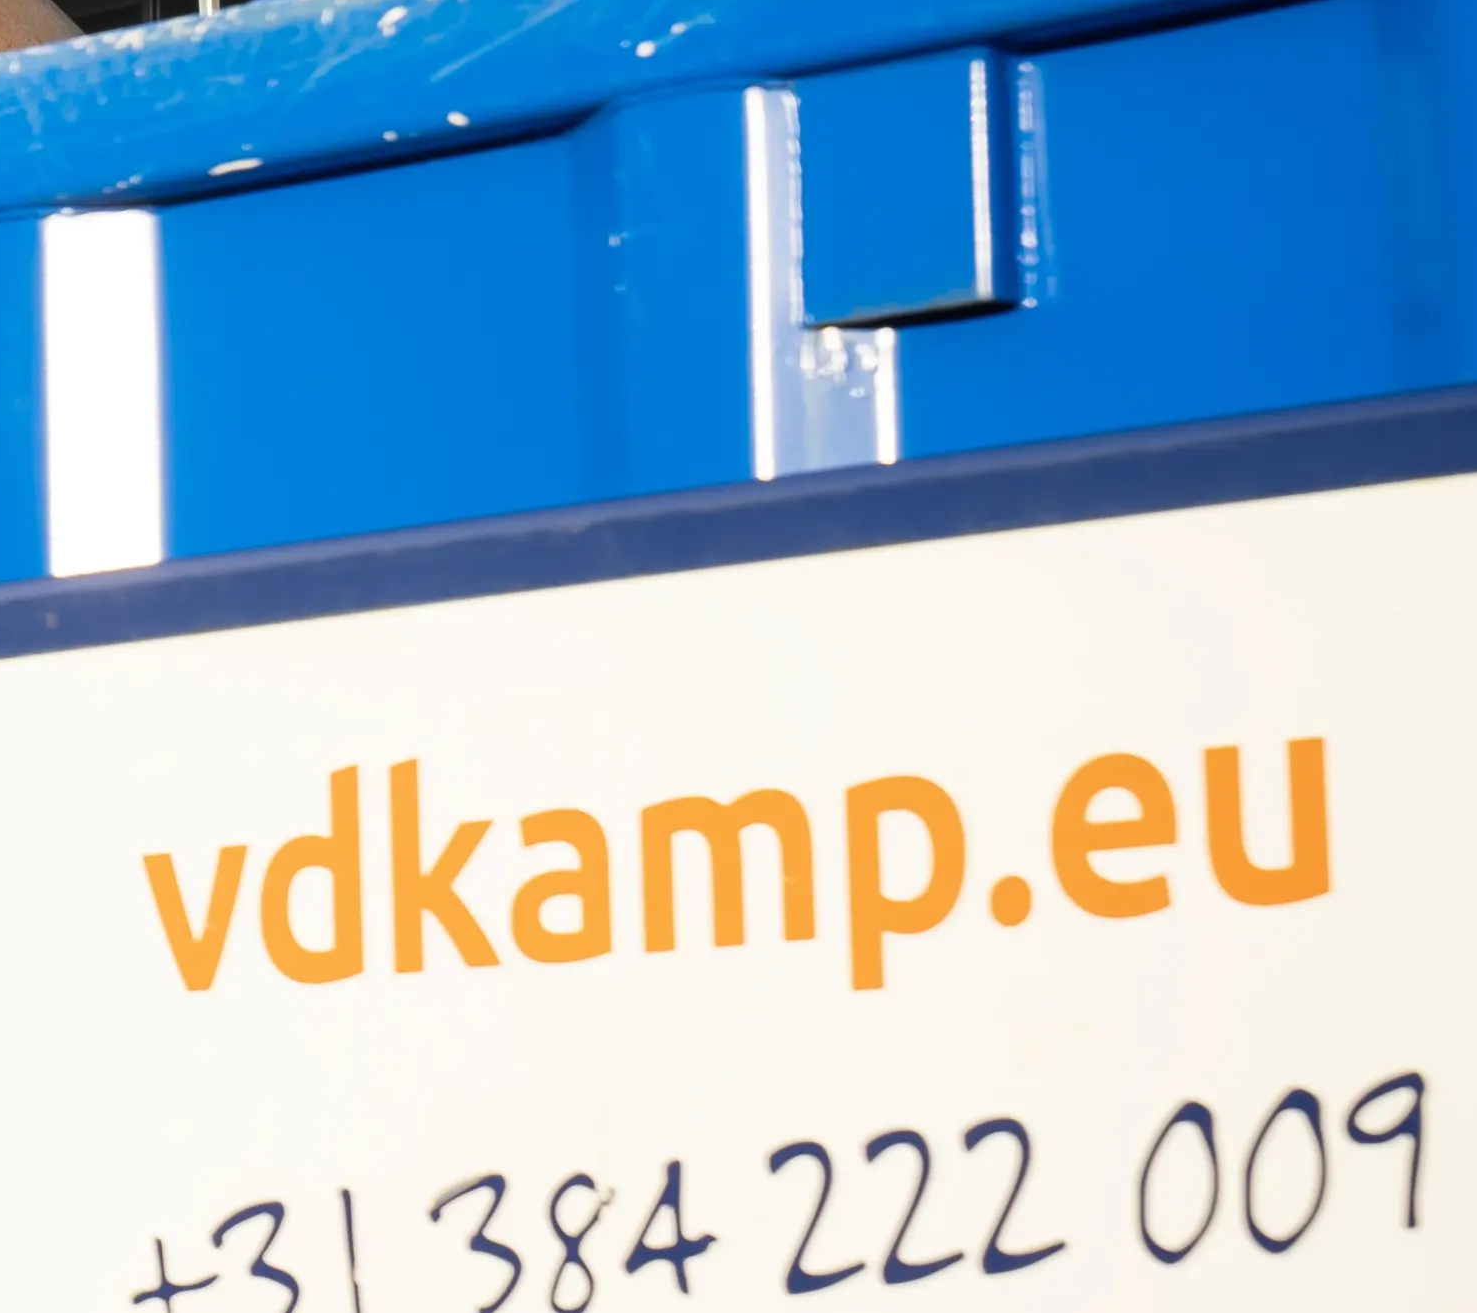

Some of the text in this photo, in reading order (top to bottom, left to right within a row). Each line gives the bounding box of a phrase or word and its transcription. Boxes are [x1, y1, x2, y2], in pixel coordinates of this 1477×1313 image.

[143, 736, 1332, 991] vdkamp.eu
[769, 1117, 1066, 1295] 222
[1139, 1072, 1426, 1265] 009
